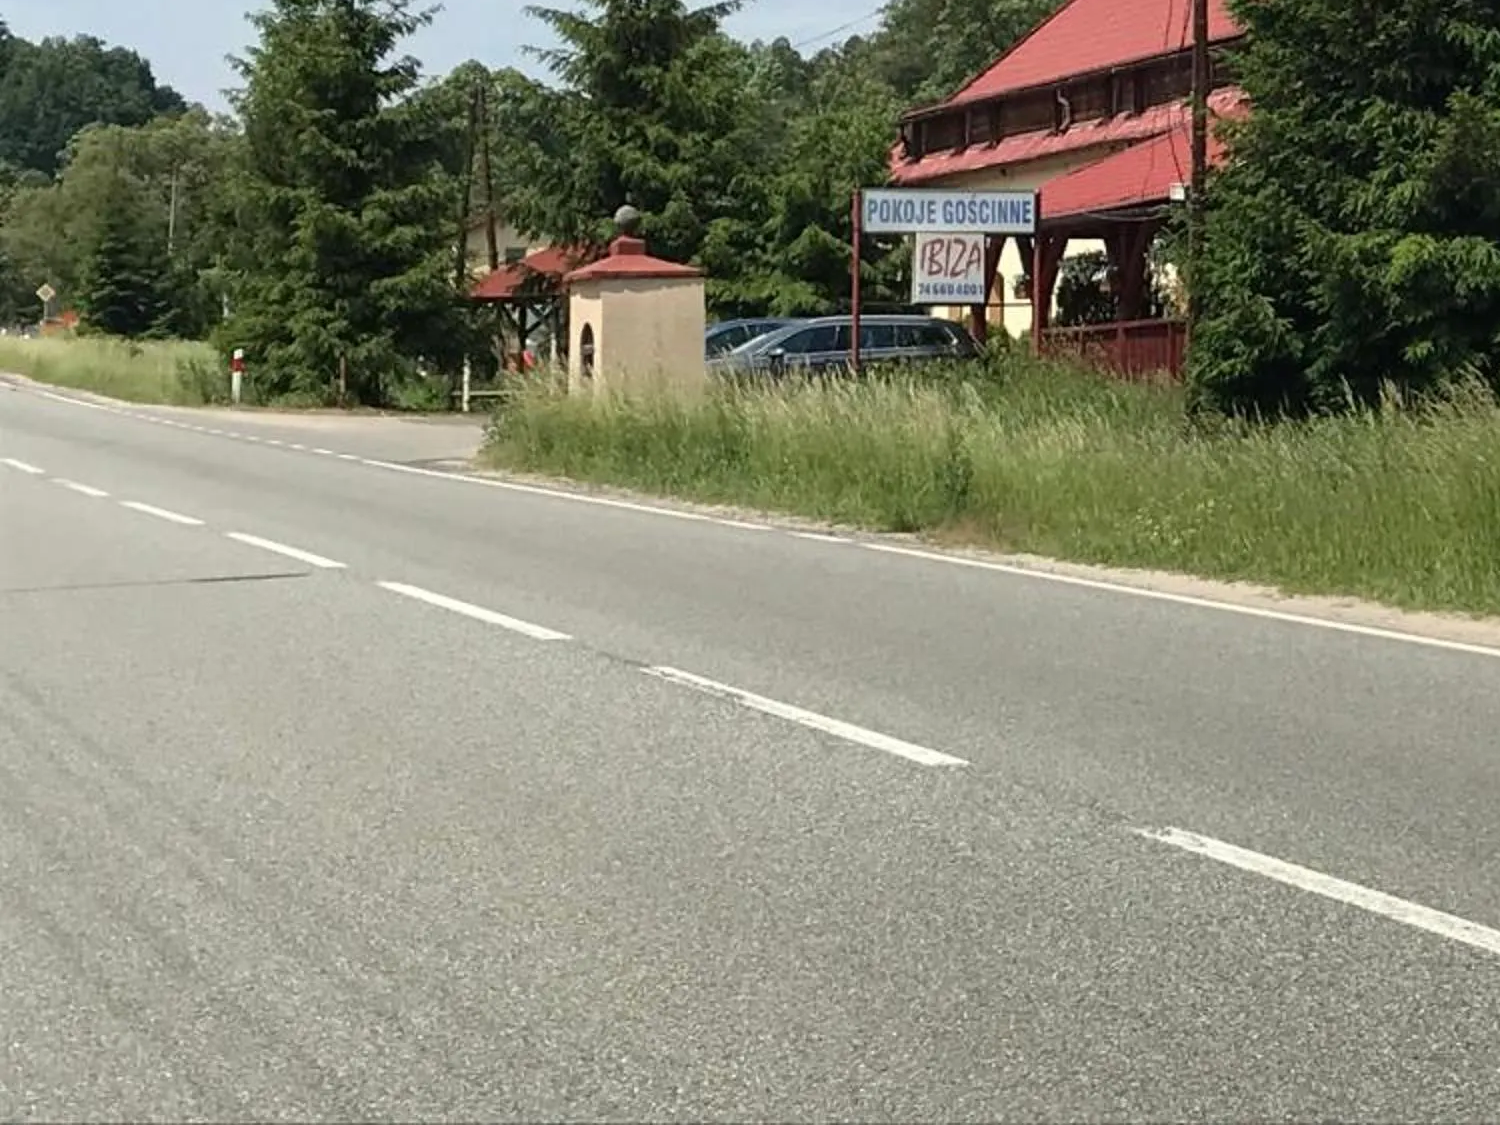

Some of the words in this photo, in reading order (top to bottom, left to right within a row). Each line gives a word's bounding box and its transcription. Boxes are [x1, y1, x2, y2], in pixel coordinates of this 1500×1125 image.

[867, 199, 937, 224] POKOJE
[942, 193, 1032, 224] GOŚCINNE
[921, 237, 982, 278] IBIZA
